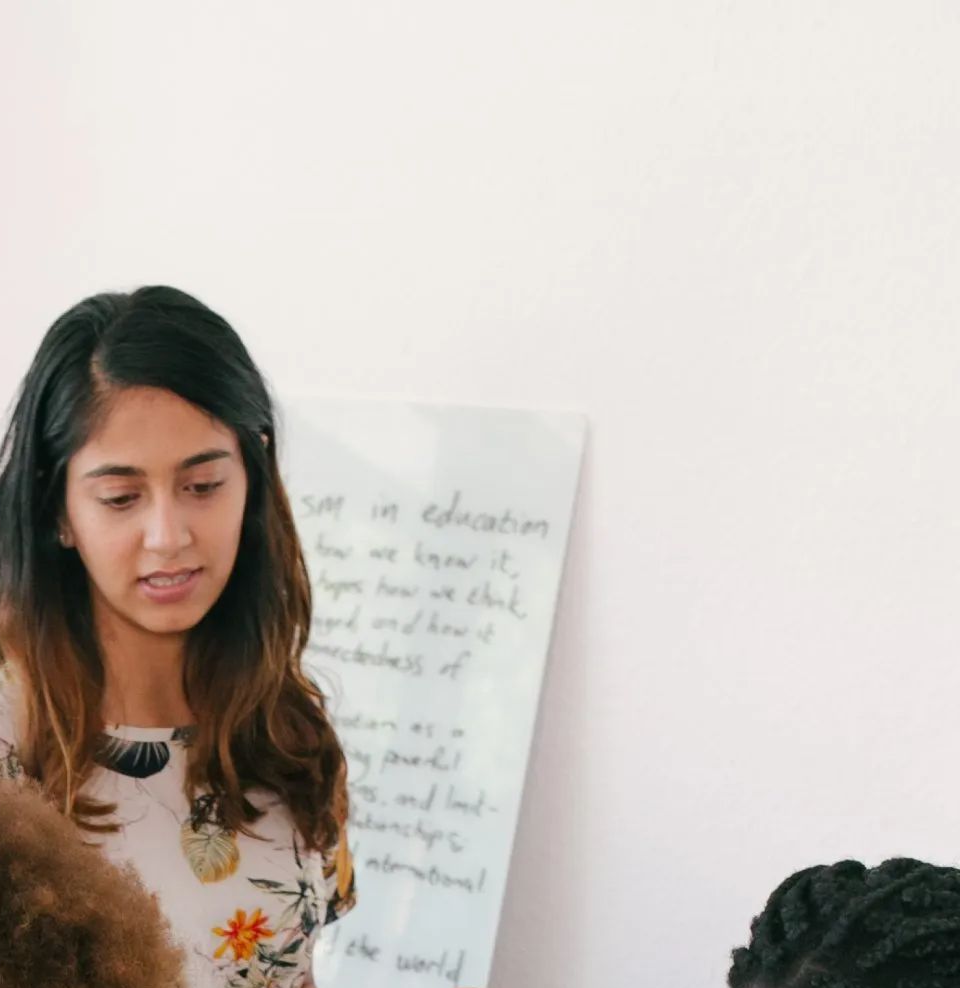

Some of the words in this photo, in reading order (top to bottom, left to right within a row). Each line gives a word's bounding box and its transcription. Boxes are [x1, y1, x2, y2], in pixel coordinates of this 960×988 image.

[370, 497, 398, 524] in
[422, 490, 549, 540] education
[369, 546, 400, 563] we
[414, 541, 480, 570] know
[373, 574, 420, 595] how
[429, 583, 457, 602] we
[426, 608, 471, 637] how
[437, 648, 472, 680] of
[345, 933, 381, 962] the
